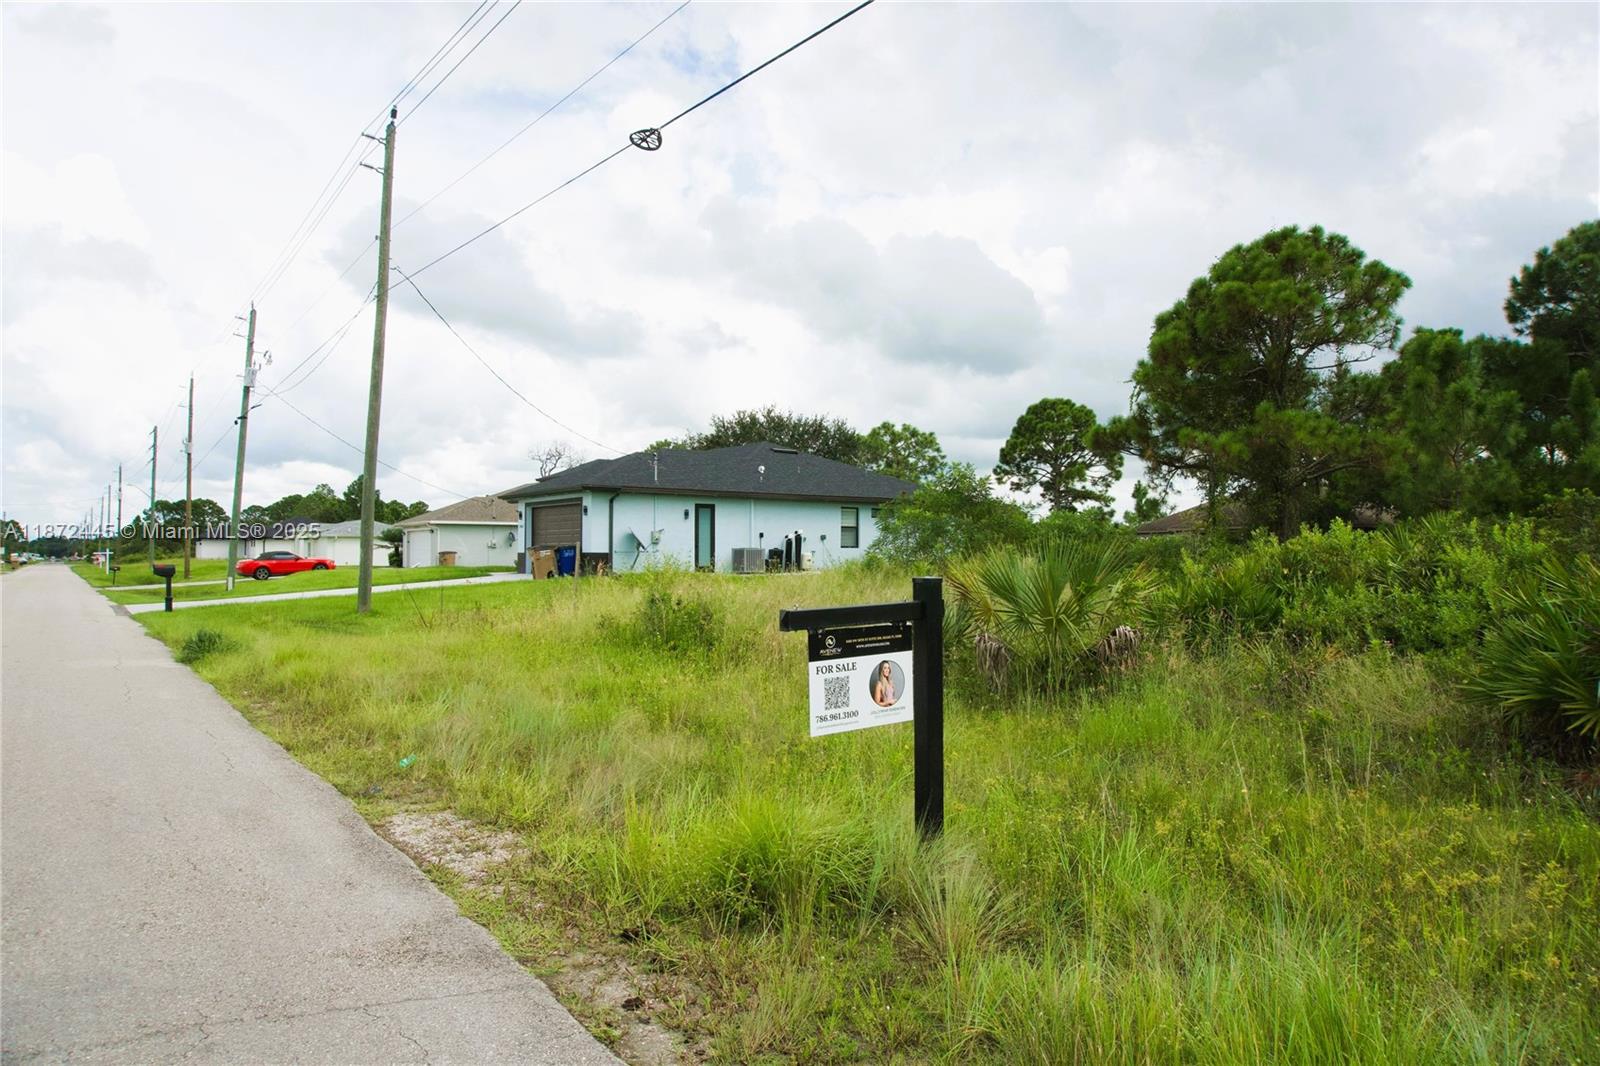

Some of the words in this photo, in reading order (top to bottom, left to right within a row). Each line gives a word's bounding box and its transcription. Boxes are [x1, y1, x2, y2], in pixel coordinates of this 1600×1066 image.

[816, 664, 834, 675] FOR
[835, 662, 857, 673] SALE
[815, 710, 859, 723] 786.961.3100
